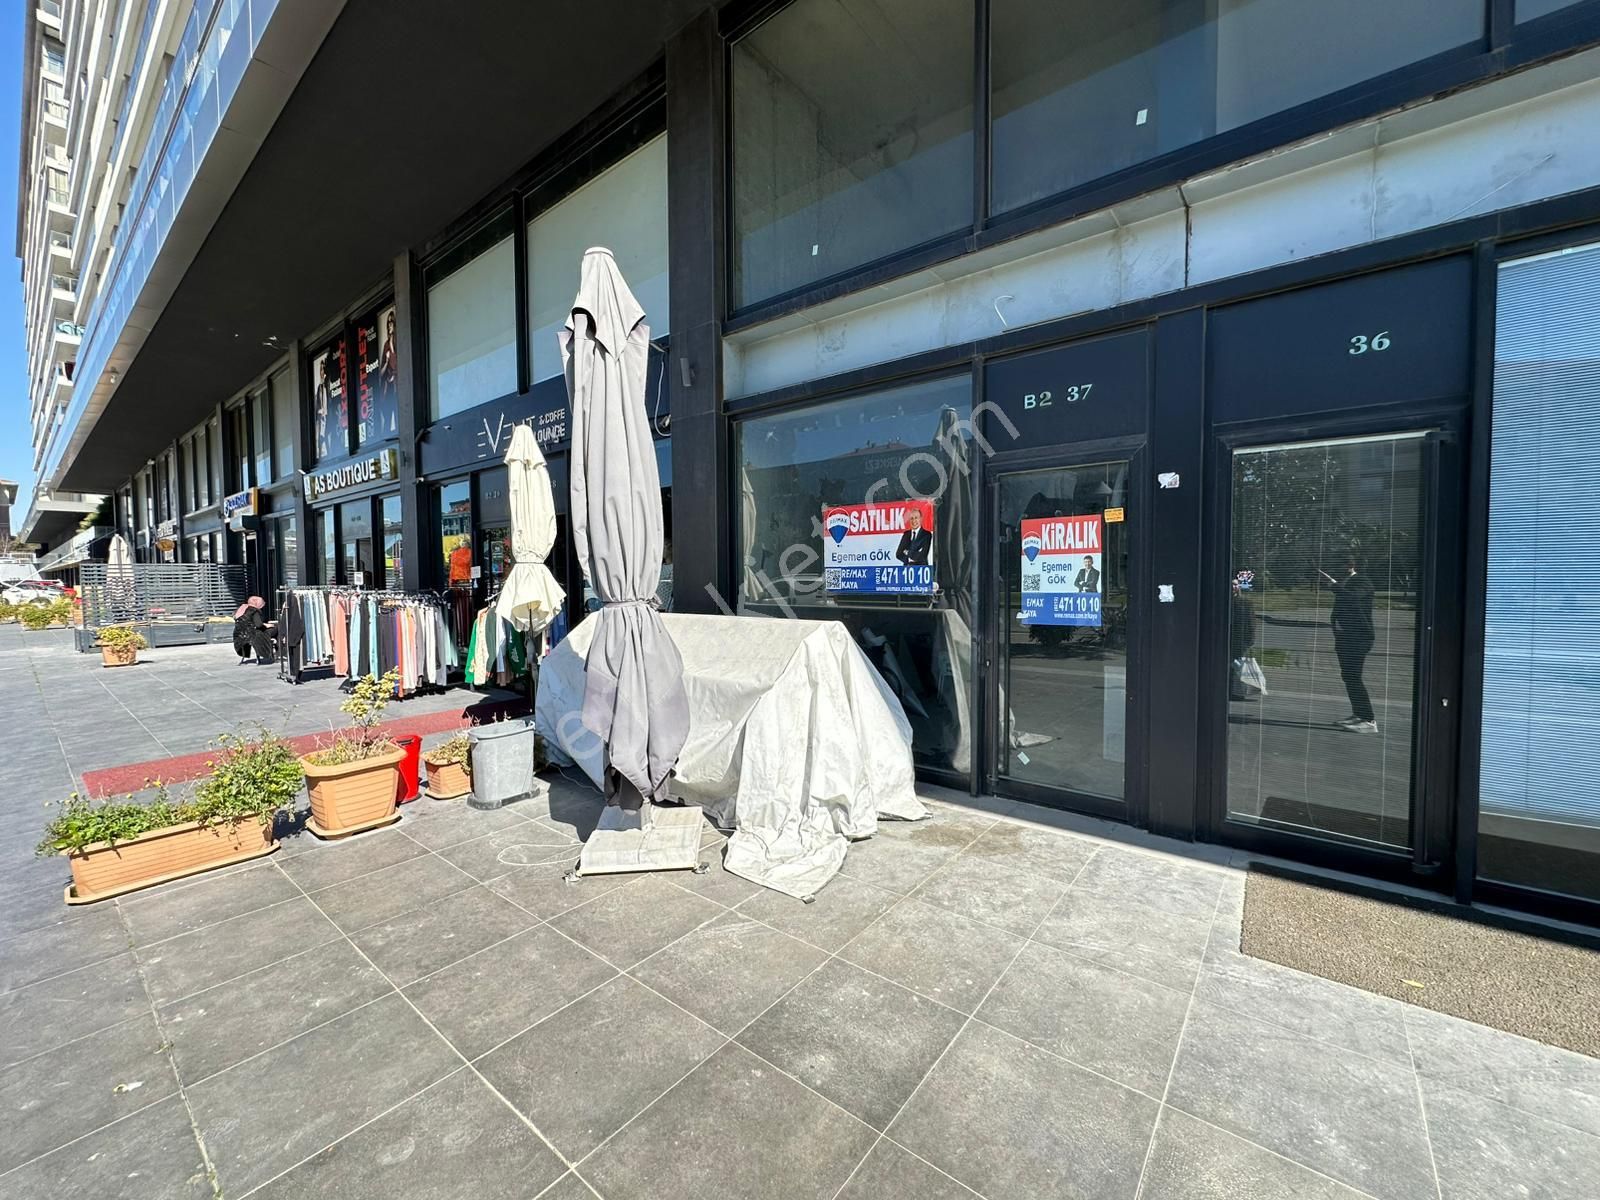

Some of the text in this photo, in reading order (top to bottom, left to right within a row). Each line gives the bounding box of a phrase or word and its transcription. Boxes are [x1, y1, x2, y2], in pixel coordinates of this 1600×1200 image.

[1348, 331, 1391, 355] 36
[1024, 383, 1093, 409] B2 37
[314, 475, 326, 494] AS
[326, 458, 377, 491] BOUTIQUE
[850, 507, 906, 533] SATILIK
[831, 548, 891, 563] Egemen GÖK
[841, 568, 867, 578] RE/MAX
[1041, 561, 1072, 573] Egemen
[881, 566, 931, 584] 471 10 10
[1047, 574, 1067, 584] GÖK
[841, 581, 859, 589] KAYA
[1058, 597, 1100, 612] 471 10 10
